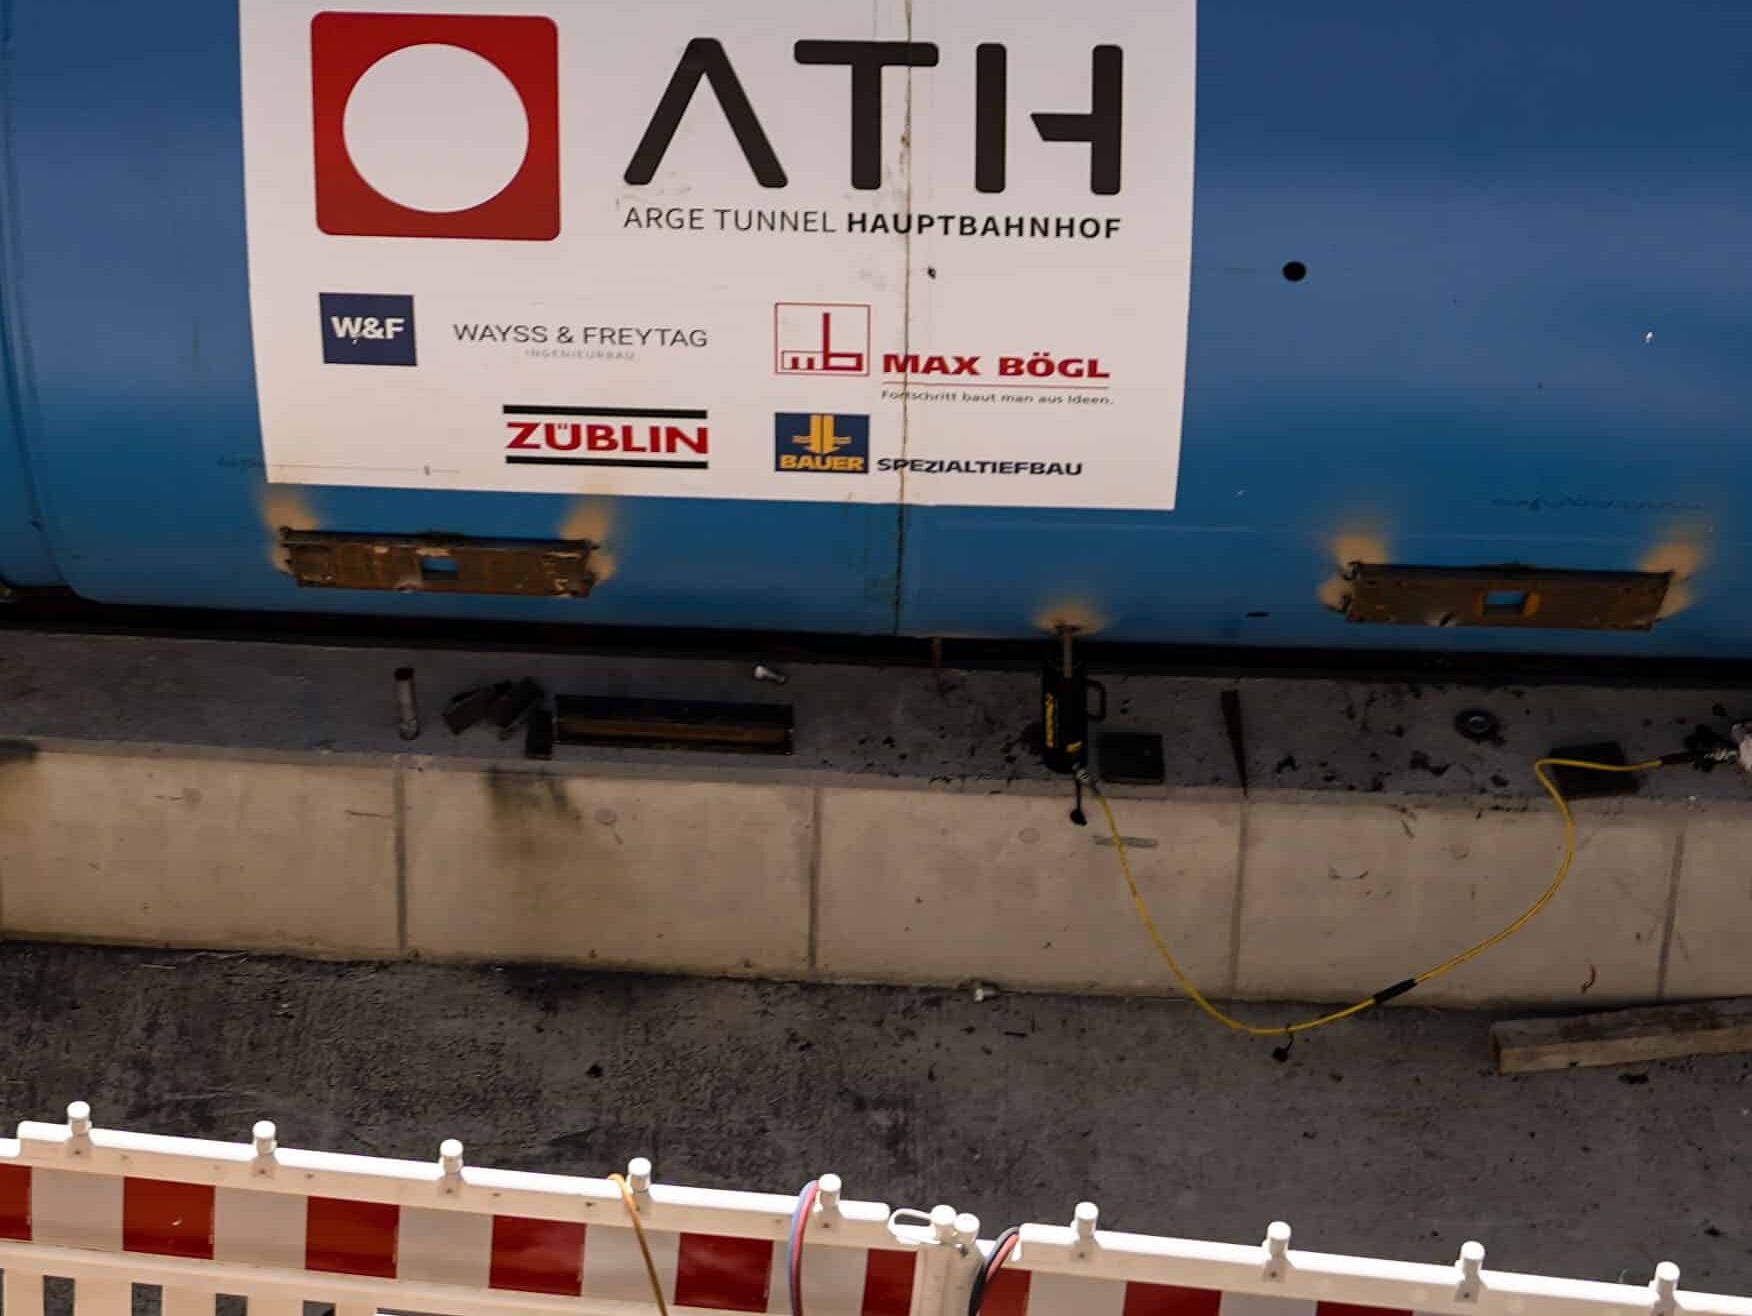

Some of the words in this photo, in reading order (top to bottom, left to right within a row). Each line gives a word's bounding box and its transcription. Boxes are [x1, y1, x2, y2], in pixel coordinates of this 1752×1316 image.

[622, 37, 1124, 195] ATH
[623, 207, 704, 231] ARGE
[713, 208, 836, 233] TUNNEL
[847, 211, 1121, 239] HAUPTBAHNHOF
[331, 316, 405, 340] W&F
[453, 324, 548, 344] WAYSS
[557, 325, 574, 344] &
[583, 326, 709, 348] FREYTAG
[882, 353, 981, 376] MAX
[999, 352, 1110, 378] BÖGL
[962, 392, 996, 403] baut
[506, 421, 709, 454] ZÜBLIN
[779, 454, 865, 471] BAUER
[878, 457, 1083, 476] SPEZIALTIEFBAU
